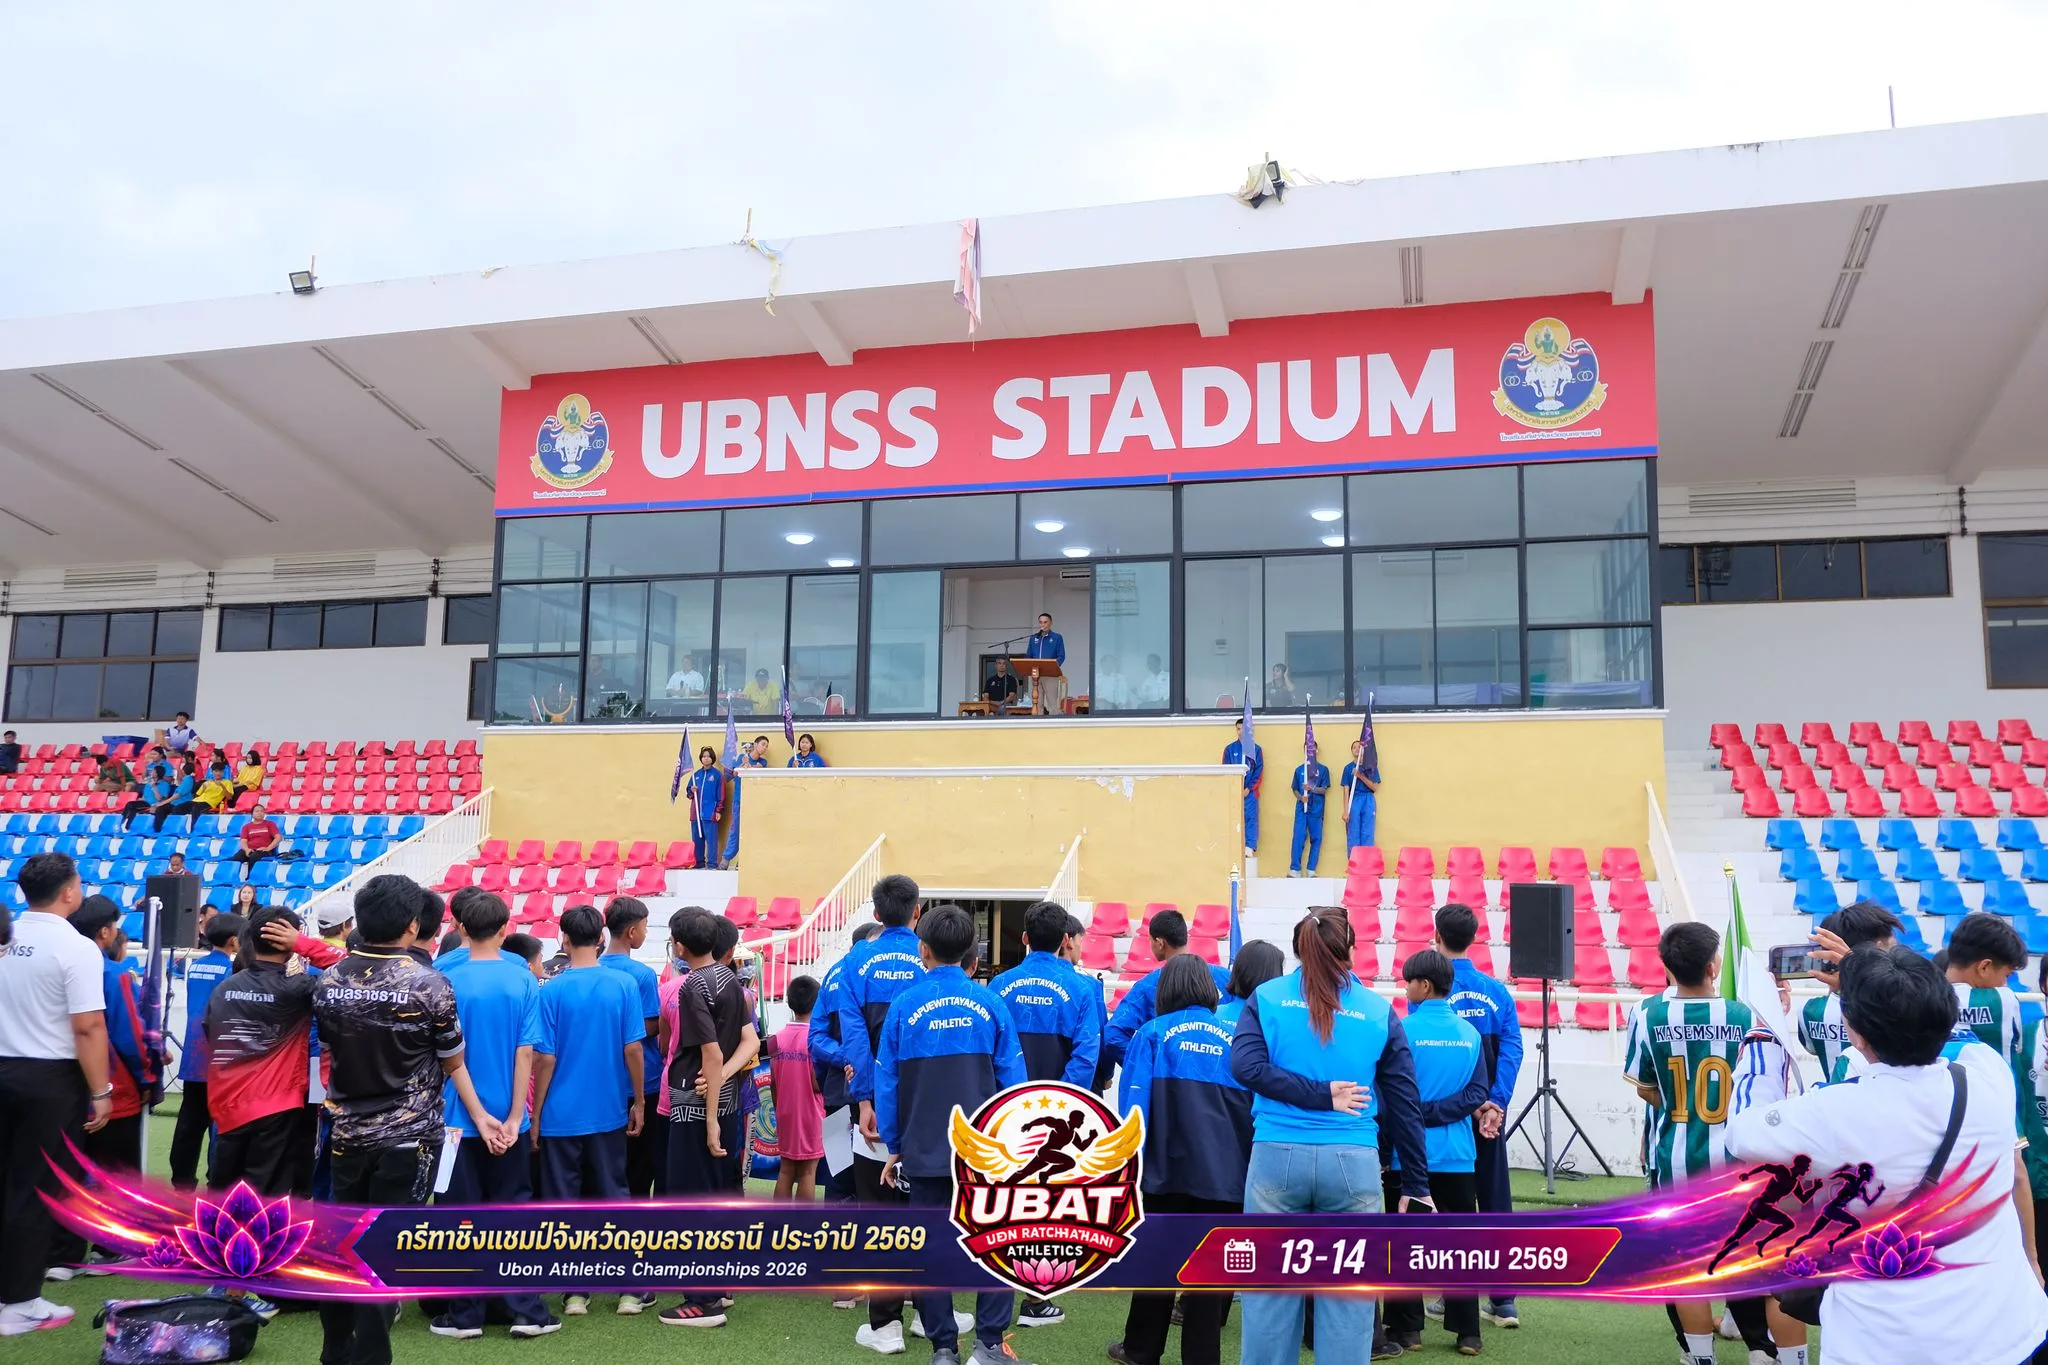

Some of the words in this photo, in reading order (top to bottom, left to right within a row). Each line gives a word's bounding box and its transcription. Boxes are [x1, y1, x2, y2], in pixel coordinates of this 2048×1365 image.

[641, 386, 939, 479] UBNSS
[992, 347, 1457, 460] STADIUM
[873, 969, 914, 980] ATHLETICS
[327, 988, 410, 1004] อุบลราชธานี
[1000, 977, 1070, 1003] SAPUEWITTAYAKARN
[1016, 994, 1053, 1006] ATHLETICS
[908, 996, 991, 1026] SAPUEWITTAYAKARN
[928, 1017, 973, 1030] ATHLETICS
[1654, 1024, 1744, 1042] KASEMSIMA
[1179, 1041, 1224, 1055] ATHLETICS
[1667, 1054, 1733, 1124] 10
